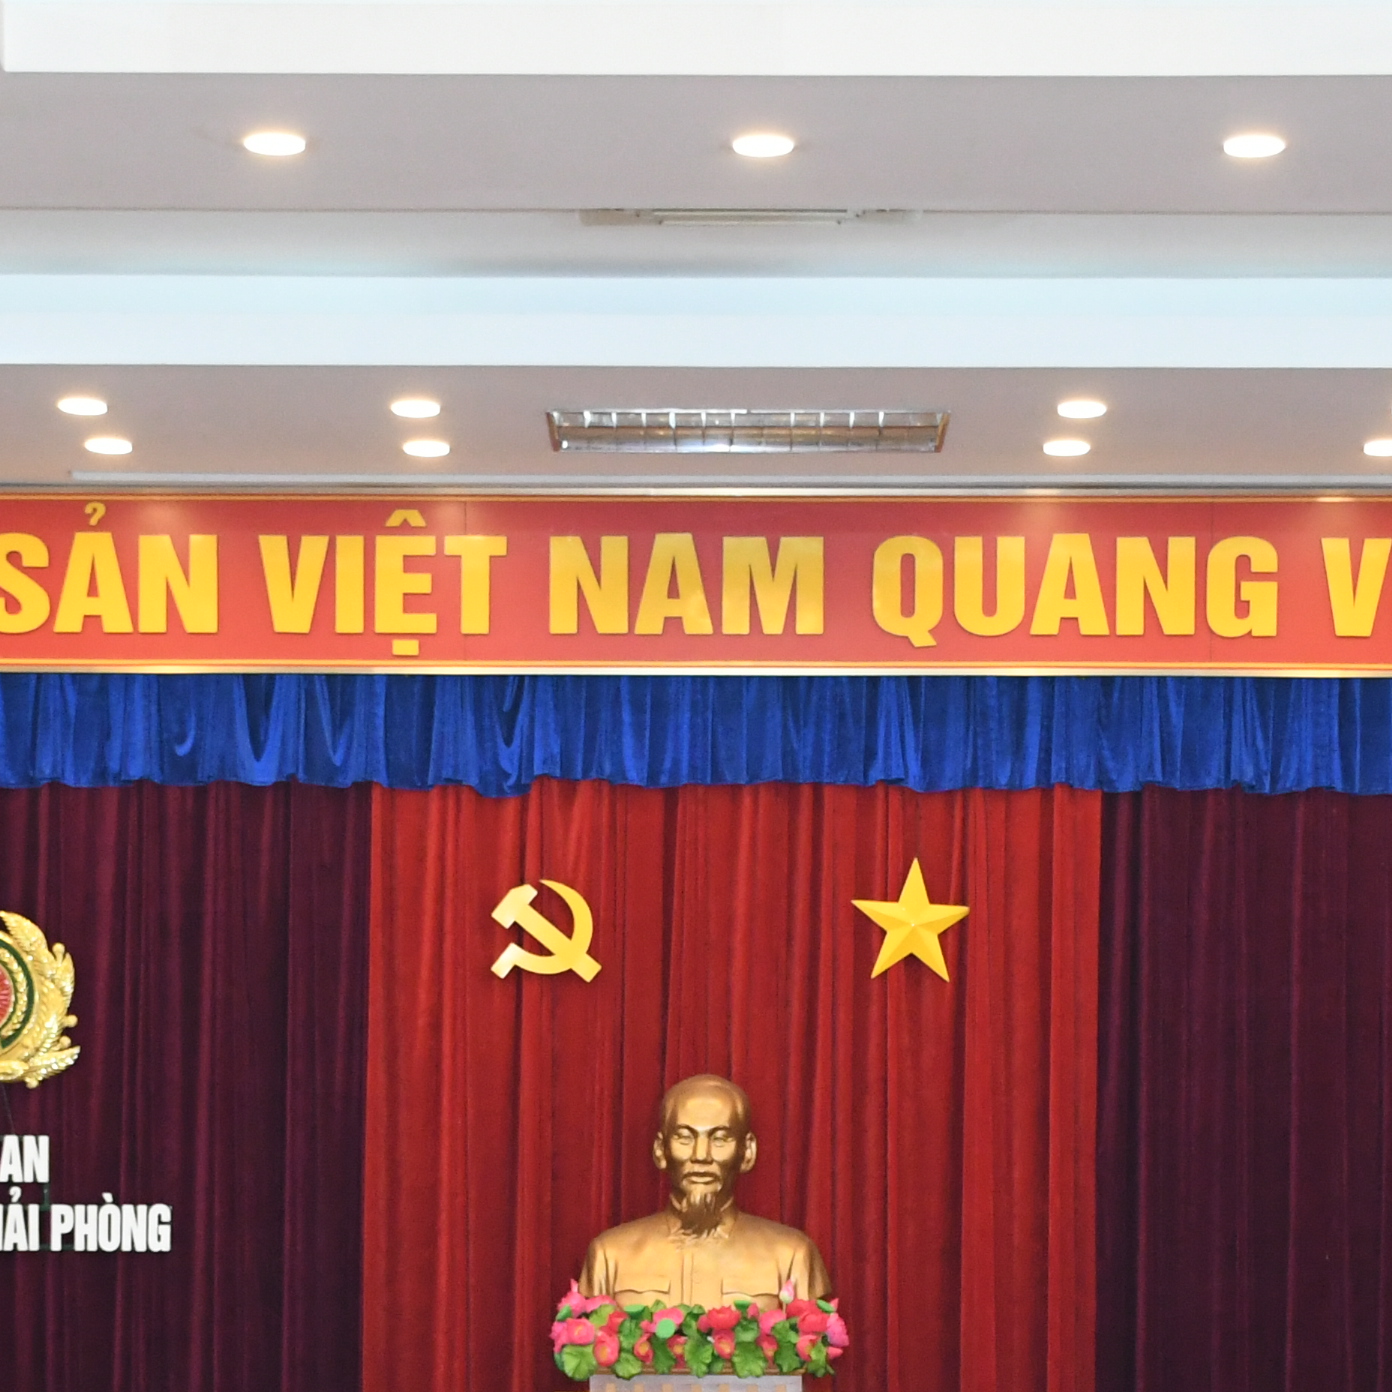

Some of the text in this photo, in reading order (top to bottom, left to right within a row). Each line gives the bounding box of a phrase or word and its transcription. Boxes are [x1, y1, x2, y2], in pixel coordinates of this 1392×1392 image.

[261, 511, 506, 654] VIỆT
[551, 535, 822, 633] NAM
[874, 535, 1277, 646] QUANG
[51, 1193, 171, 1252] PHÒNG
